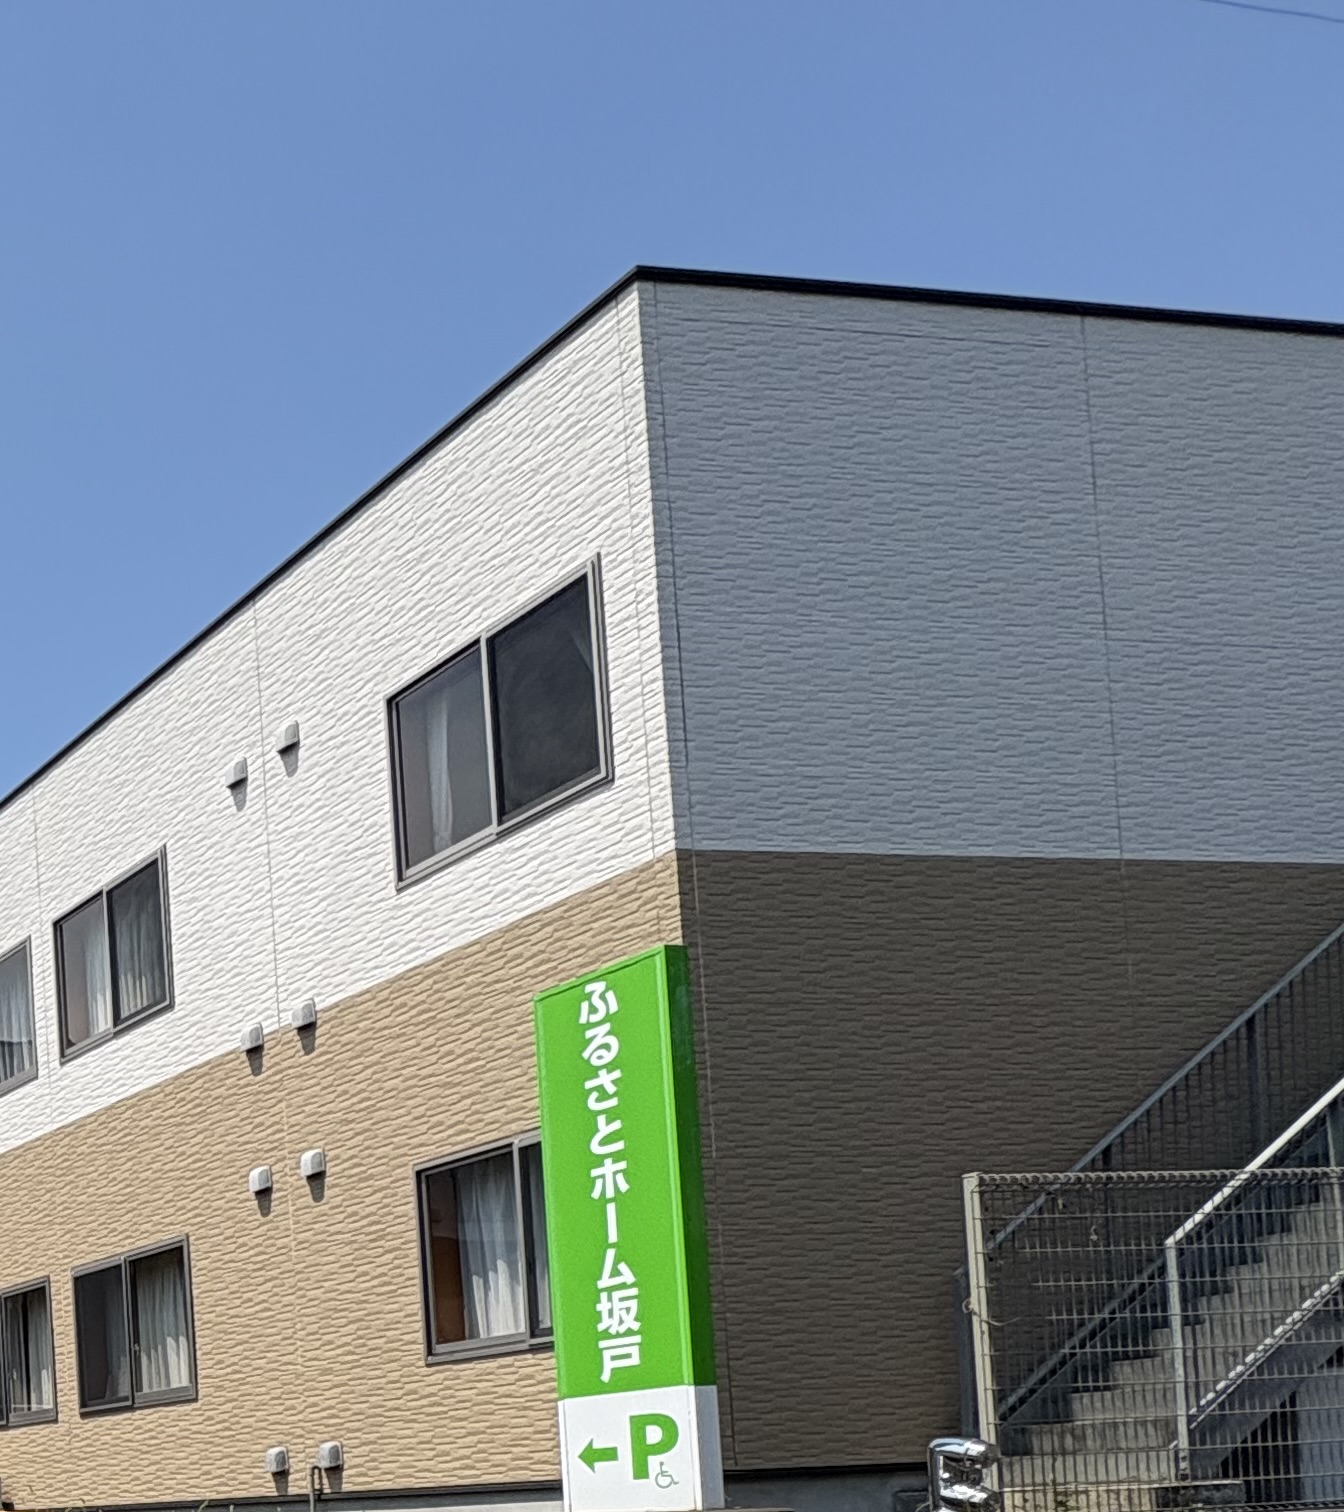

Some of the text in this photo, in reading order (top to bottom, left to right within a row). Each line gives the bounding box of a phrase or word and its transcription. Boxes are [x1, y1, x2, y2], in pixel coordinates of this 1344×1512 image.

[578, 979, 641, 1385] ふるさとホーム坂戸
[628, 1412, 680, 1480] P
